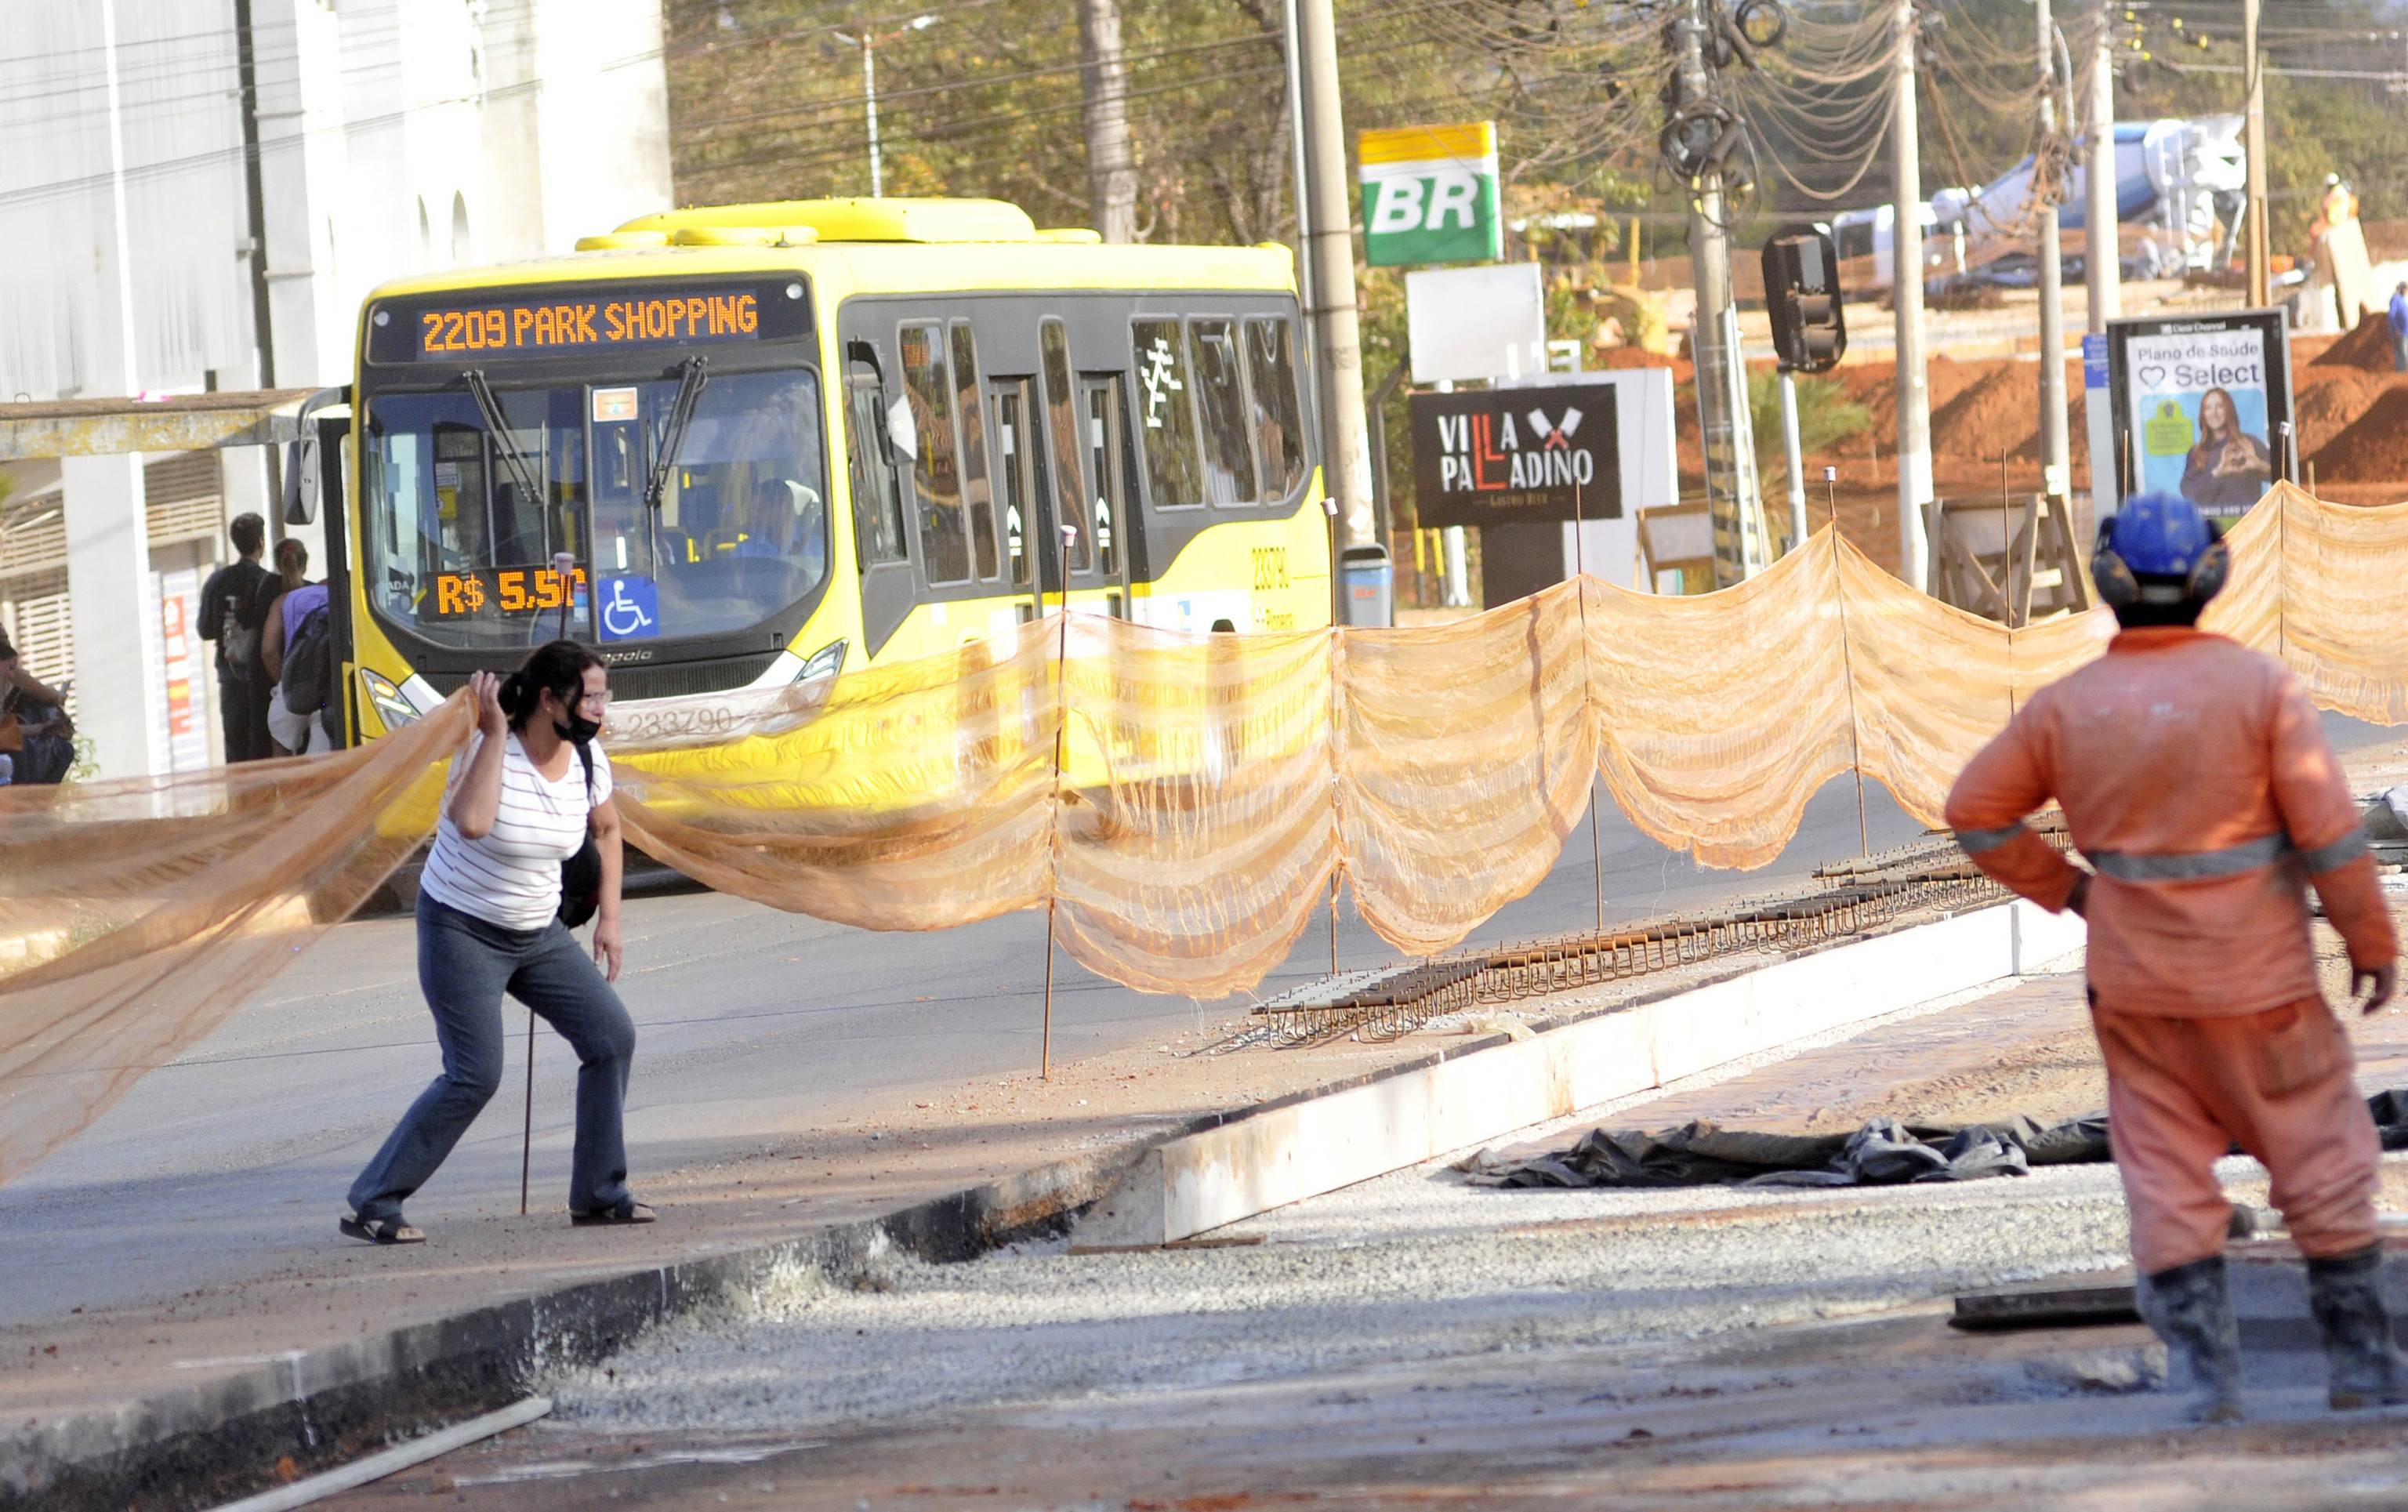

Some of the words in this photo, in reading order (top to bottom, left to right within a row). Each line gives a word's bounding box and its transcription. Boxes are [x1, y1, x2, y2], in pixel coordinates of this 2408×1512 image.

[1370, 174, 1478, 234] BR
[423, 309, 507, 352] 2209
[513, 303, 597, 346] PARK
[604, 295, 758, 340] SHOPPING
[2138, 347, 2181, 361] Plano
[2186, 343, 2205, 358] de
[2210, 342, 2258, 357] Saúde
[2175, 363, 2261, 387] Select
[1438, 412, 1519, 461] VILLA
[437, 574, 484, 614] R$
[629, 708, 731, 736] 233790
